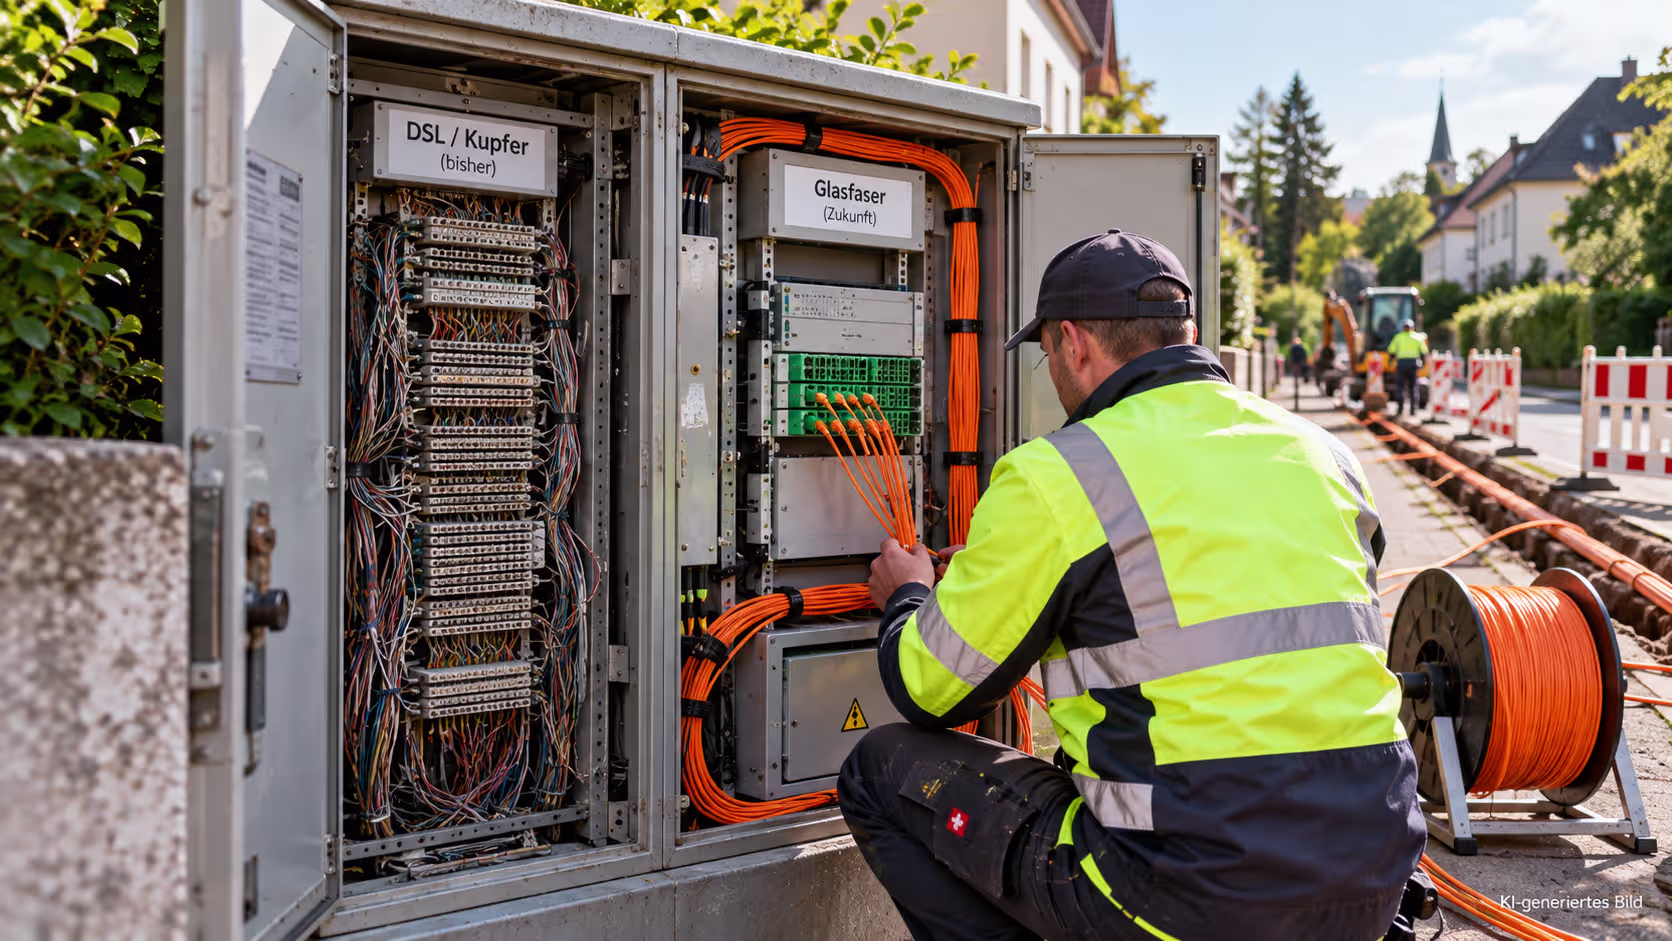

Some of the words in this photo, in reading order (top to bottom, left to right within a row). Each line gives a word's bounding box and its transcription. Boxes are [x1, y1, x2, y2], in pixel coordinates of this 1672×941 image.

[406, 120, 446, 145] DSL
[450, 126, 459, 148] /
[465, 128, 529, 156] Kupfer
[440, 153, 496, 178] (bisher)
[814, 179, 886, 204] Glasfaser
[823, 205, 877, 227] (Zukunft)
